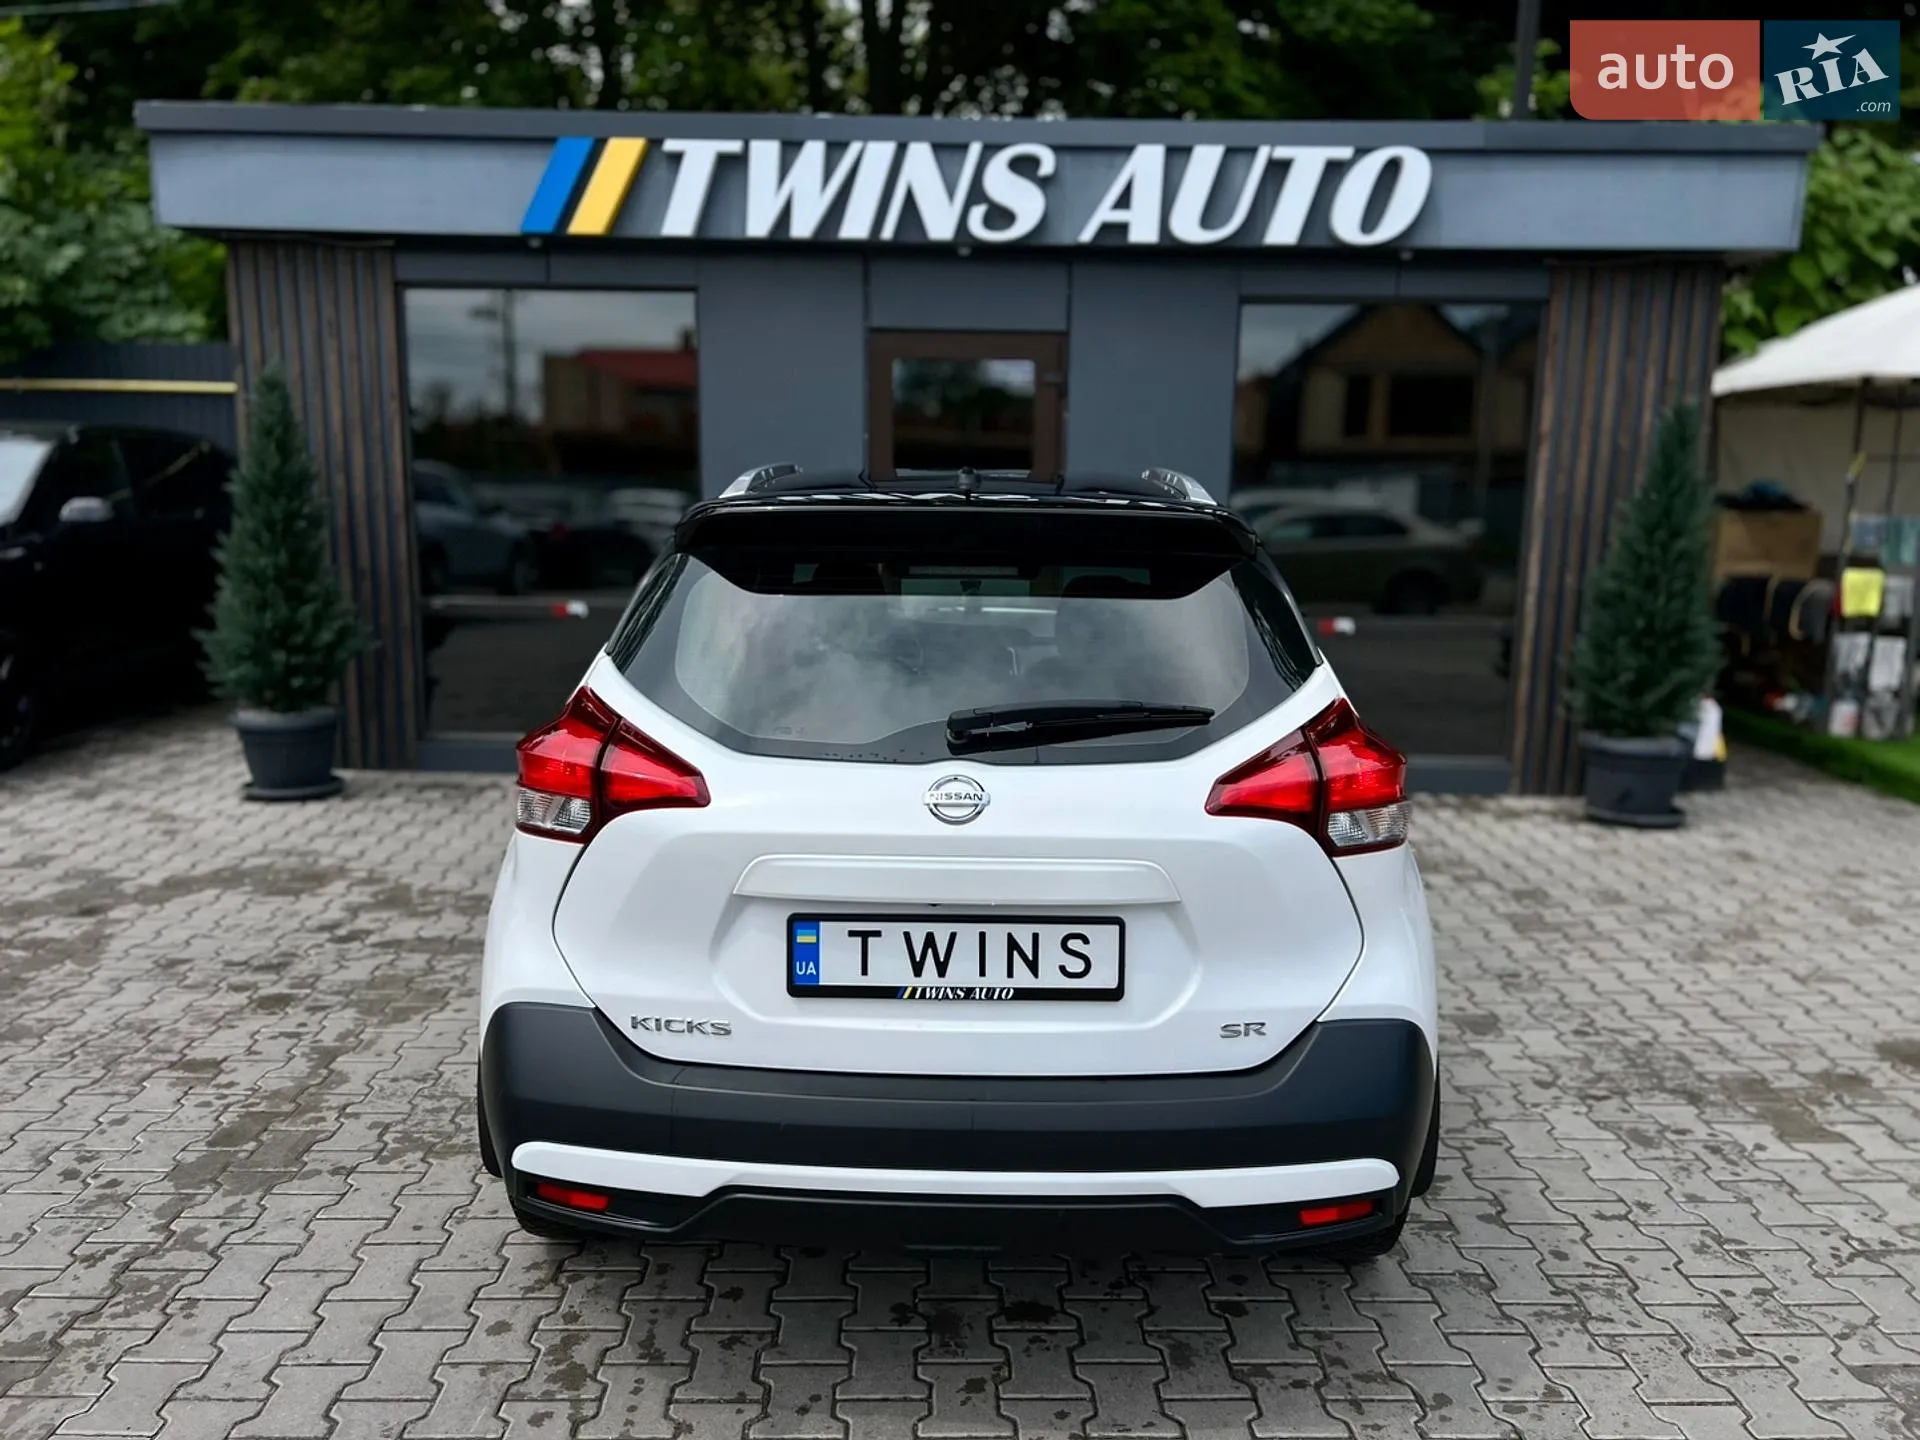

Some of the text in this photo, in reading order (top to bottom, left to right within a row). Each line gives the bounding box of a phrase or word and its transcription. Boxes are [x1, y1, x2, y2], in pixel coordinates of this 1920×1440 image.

[660, 138, 1432, 246] TWINS AUTO
[929, 792, 983, 802] NISSAN
[847, 930, 1092, 979] TWINS
[795, 961, 817, 976] UA
[914, 986, 1015, 1000] TWINS AUTO
[630, 1015, 732, 1036] KICKS
[1220, 1021, 1267, 1039] SR
